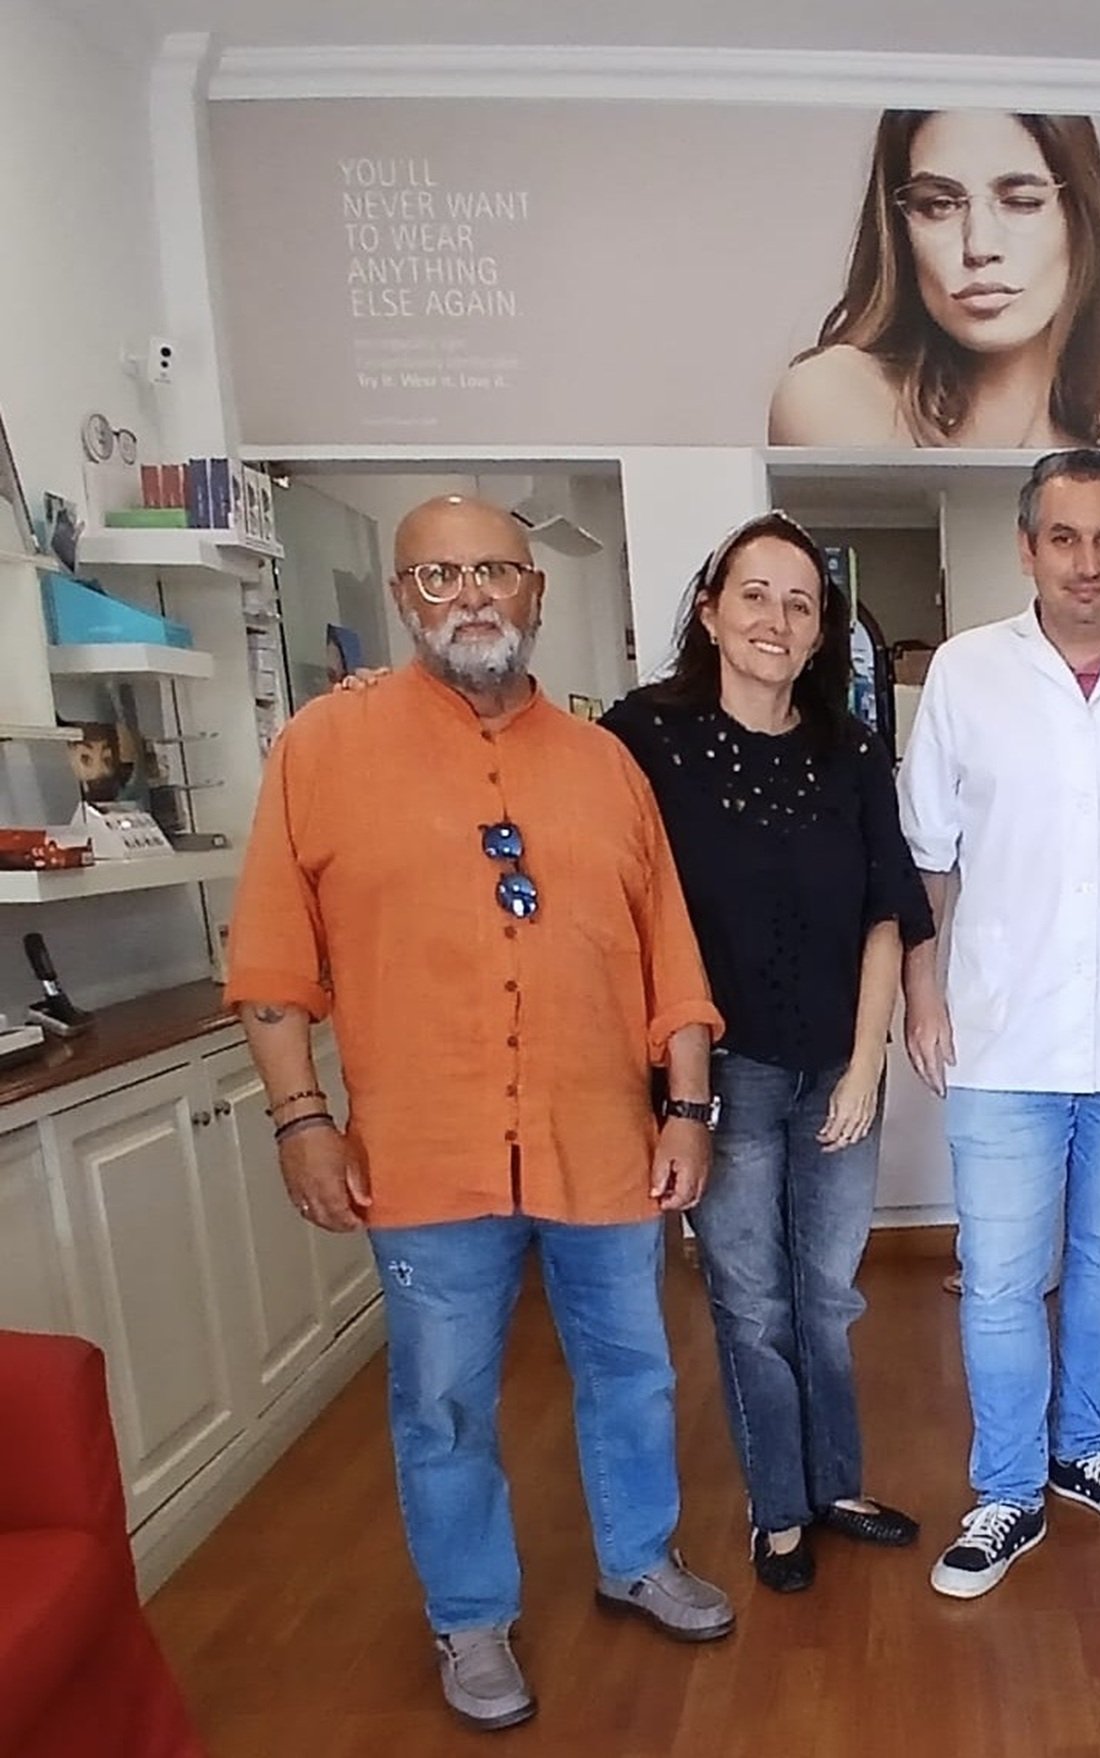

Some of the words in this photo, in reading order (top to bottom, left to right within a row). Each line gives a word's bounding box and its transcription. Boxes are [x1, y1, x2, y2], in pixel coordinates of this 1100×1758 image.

[343, 190, 435, 219] NEVER
[446, 191, 529, 219] WANT
[345, 223, 379, 252] TO
[391, 224, 475, 252] WEAR
[347, 256, 499, 285] ANYTHING
[351, 289, 415, 317] ELSE
